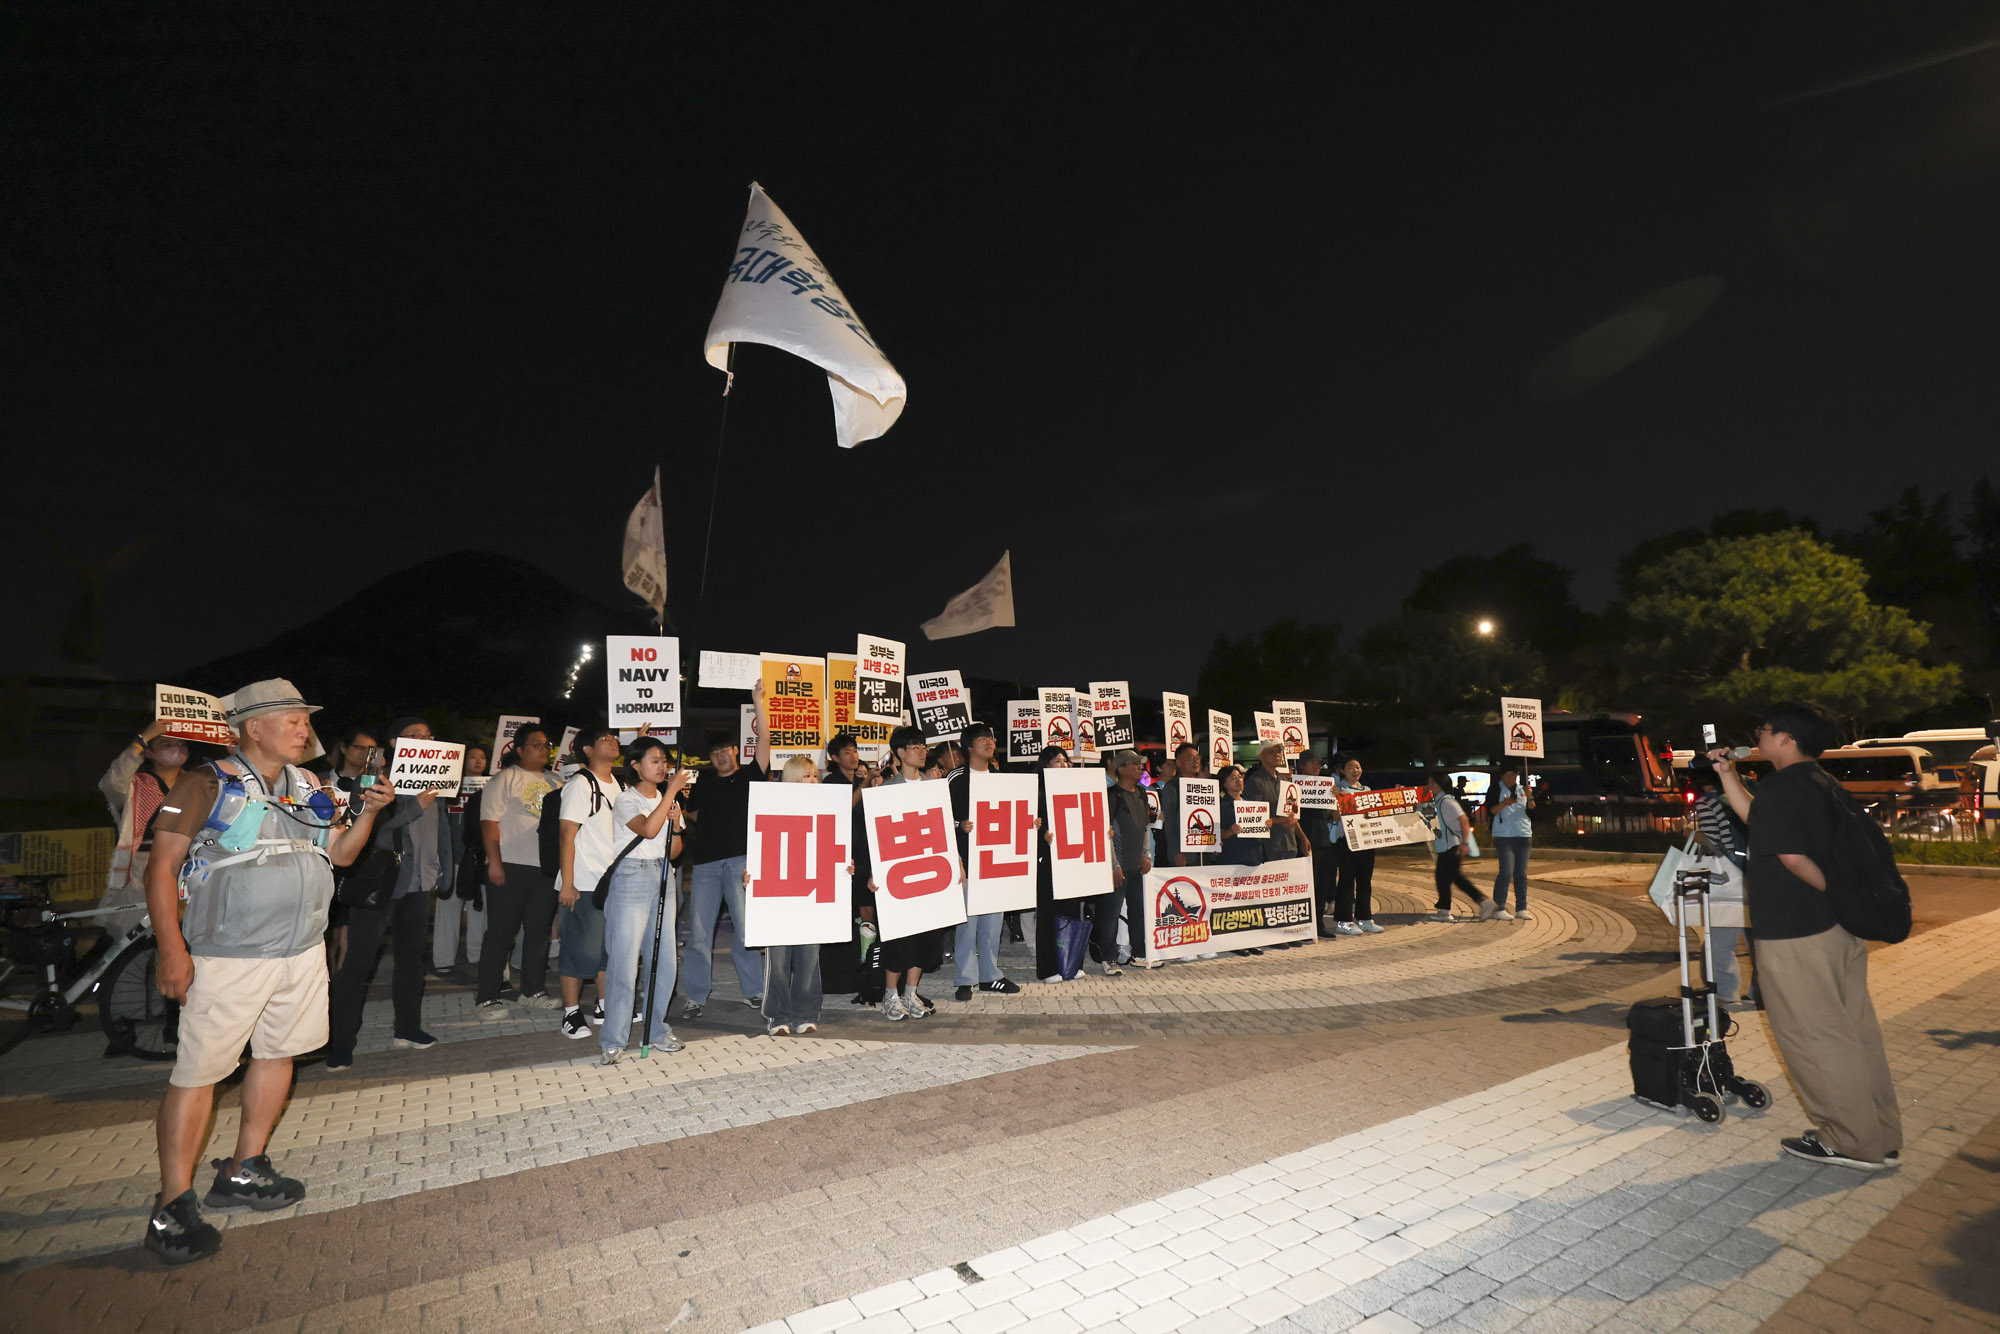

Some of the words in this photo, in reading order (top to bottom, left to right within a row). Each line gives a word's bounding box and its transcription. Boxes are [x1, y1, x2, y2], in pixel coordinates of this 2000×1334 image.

[631, 648, 657, 661] NO
[869, 644, 895, 659] 정부는
[619, 668, 669, 682] NAVY
[863, 659, 881, 673] 파병
[883, 662, 899, 676] 요구
[775, 681, 813, 697] 미국은
[863, 681, 886, 696] 거부
[919, 677, 948, 689] 미국의
[636, 688, 653, 698] TO
[916, 690, 936, 702] 파병
[938, 688, 959, 699] 압박
[1098, 687, 1120, 698] 정부는
[160, 693, 211, 708] 대미투자,
[616, 703, 674, 713] HORMUZ!
[769, 697, 820, 713] 호르무즈
[871, 697, 899, 713] 하라!
[1045, 703, 1073, 713] 중단하라!
[1094, 700, 1110, 711] 파병
[1111, 699, 1127, 710] 요구
[160, 706, 208, 719] 파병압박
[921, 706, 949, 724] 규탄
[1017, 708, 1040, 717] 정부는
[1508, 710, 1537, 720] 거부하라!
[769, 714, 820, 730] 파병압박
[935, 716, 968, 734] 한다!
[1012, 719, 1029, 728] 파병
[1096, 716, 1116, 731] 거부
[769, 731, 820, 746] 중단하라
[1013, 731, 1033, 744] 거부
[1104, 728, 1130, 745] 하라!
[397, 748, 417, 758] DO
[418, 748, 442, 759] NOT
[442, 750, 460, 761] JOIN
[396, 764, 406, 773] A
[409, 764, 438, 775] WAR
[438, 765, 451, 775] OF
[394, 779, 459, 790] AGGRESSION!
[1186, 784, 1214, 794] 파병논의
[1186, 795, 1216, 805] 중단하라!
[1354, 792, 1383, 811] 호르무즈
[1403, 788, 1419, 805] 티켓
[1051, 791, 1106, 865] 대
[976, 799, 1034, 879] 반
[752, 814, 846, 904] 파
[874, 807, 954, 900] 병
[1210, 877, 1231, 888] 미국은
[1232, 875, 1260, 887] 침략전쟁
[1261, 872, 1289, 884] 중단하라!
[1210, 892, 1233, 903] 정부는
[1233, 889, 1261, 901] 파병압박
[1262, 887, 1281, 898] 단호히
[1282, 884, 1309, 896] 거부하라!
[1155, 916, 1182, 927] 호르무즈
[1212, 908, 1264, 931] 파병반대
[1264, 902, 1310, 927] 평화행진
[1156, 922, 1208, 948] 파병반대
